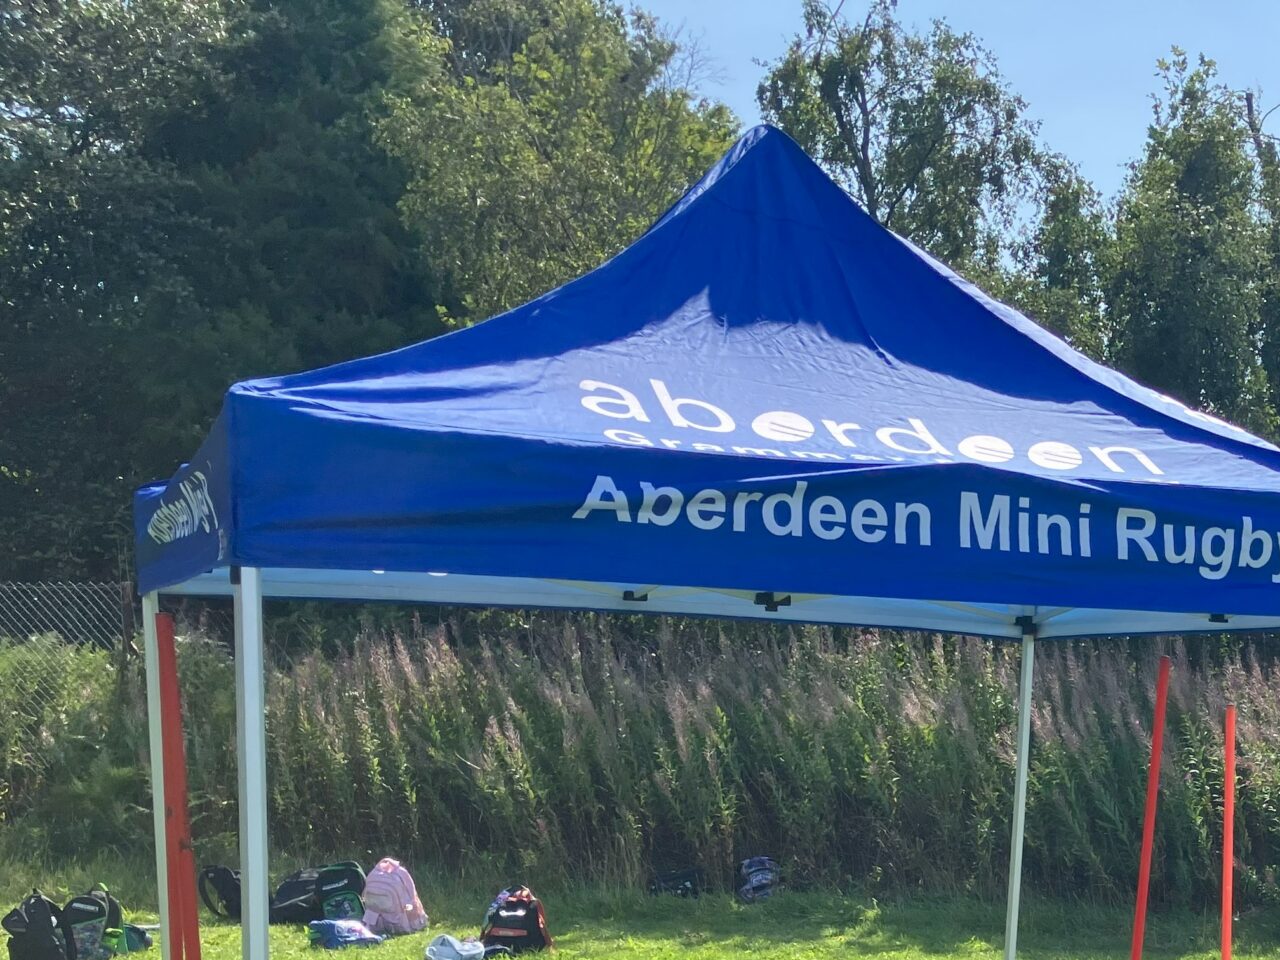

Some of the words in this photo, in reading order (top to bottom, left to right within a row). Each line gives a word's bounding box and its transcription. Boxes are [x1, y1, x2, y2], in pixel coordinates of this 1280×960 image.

[579, 378, 1164, 475] aberdeen
[573, 475, 931, 547] Aberdeen
[959, 491, 1091, 558] Mini
